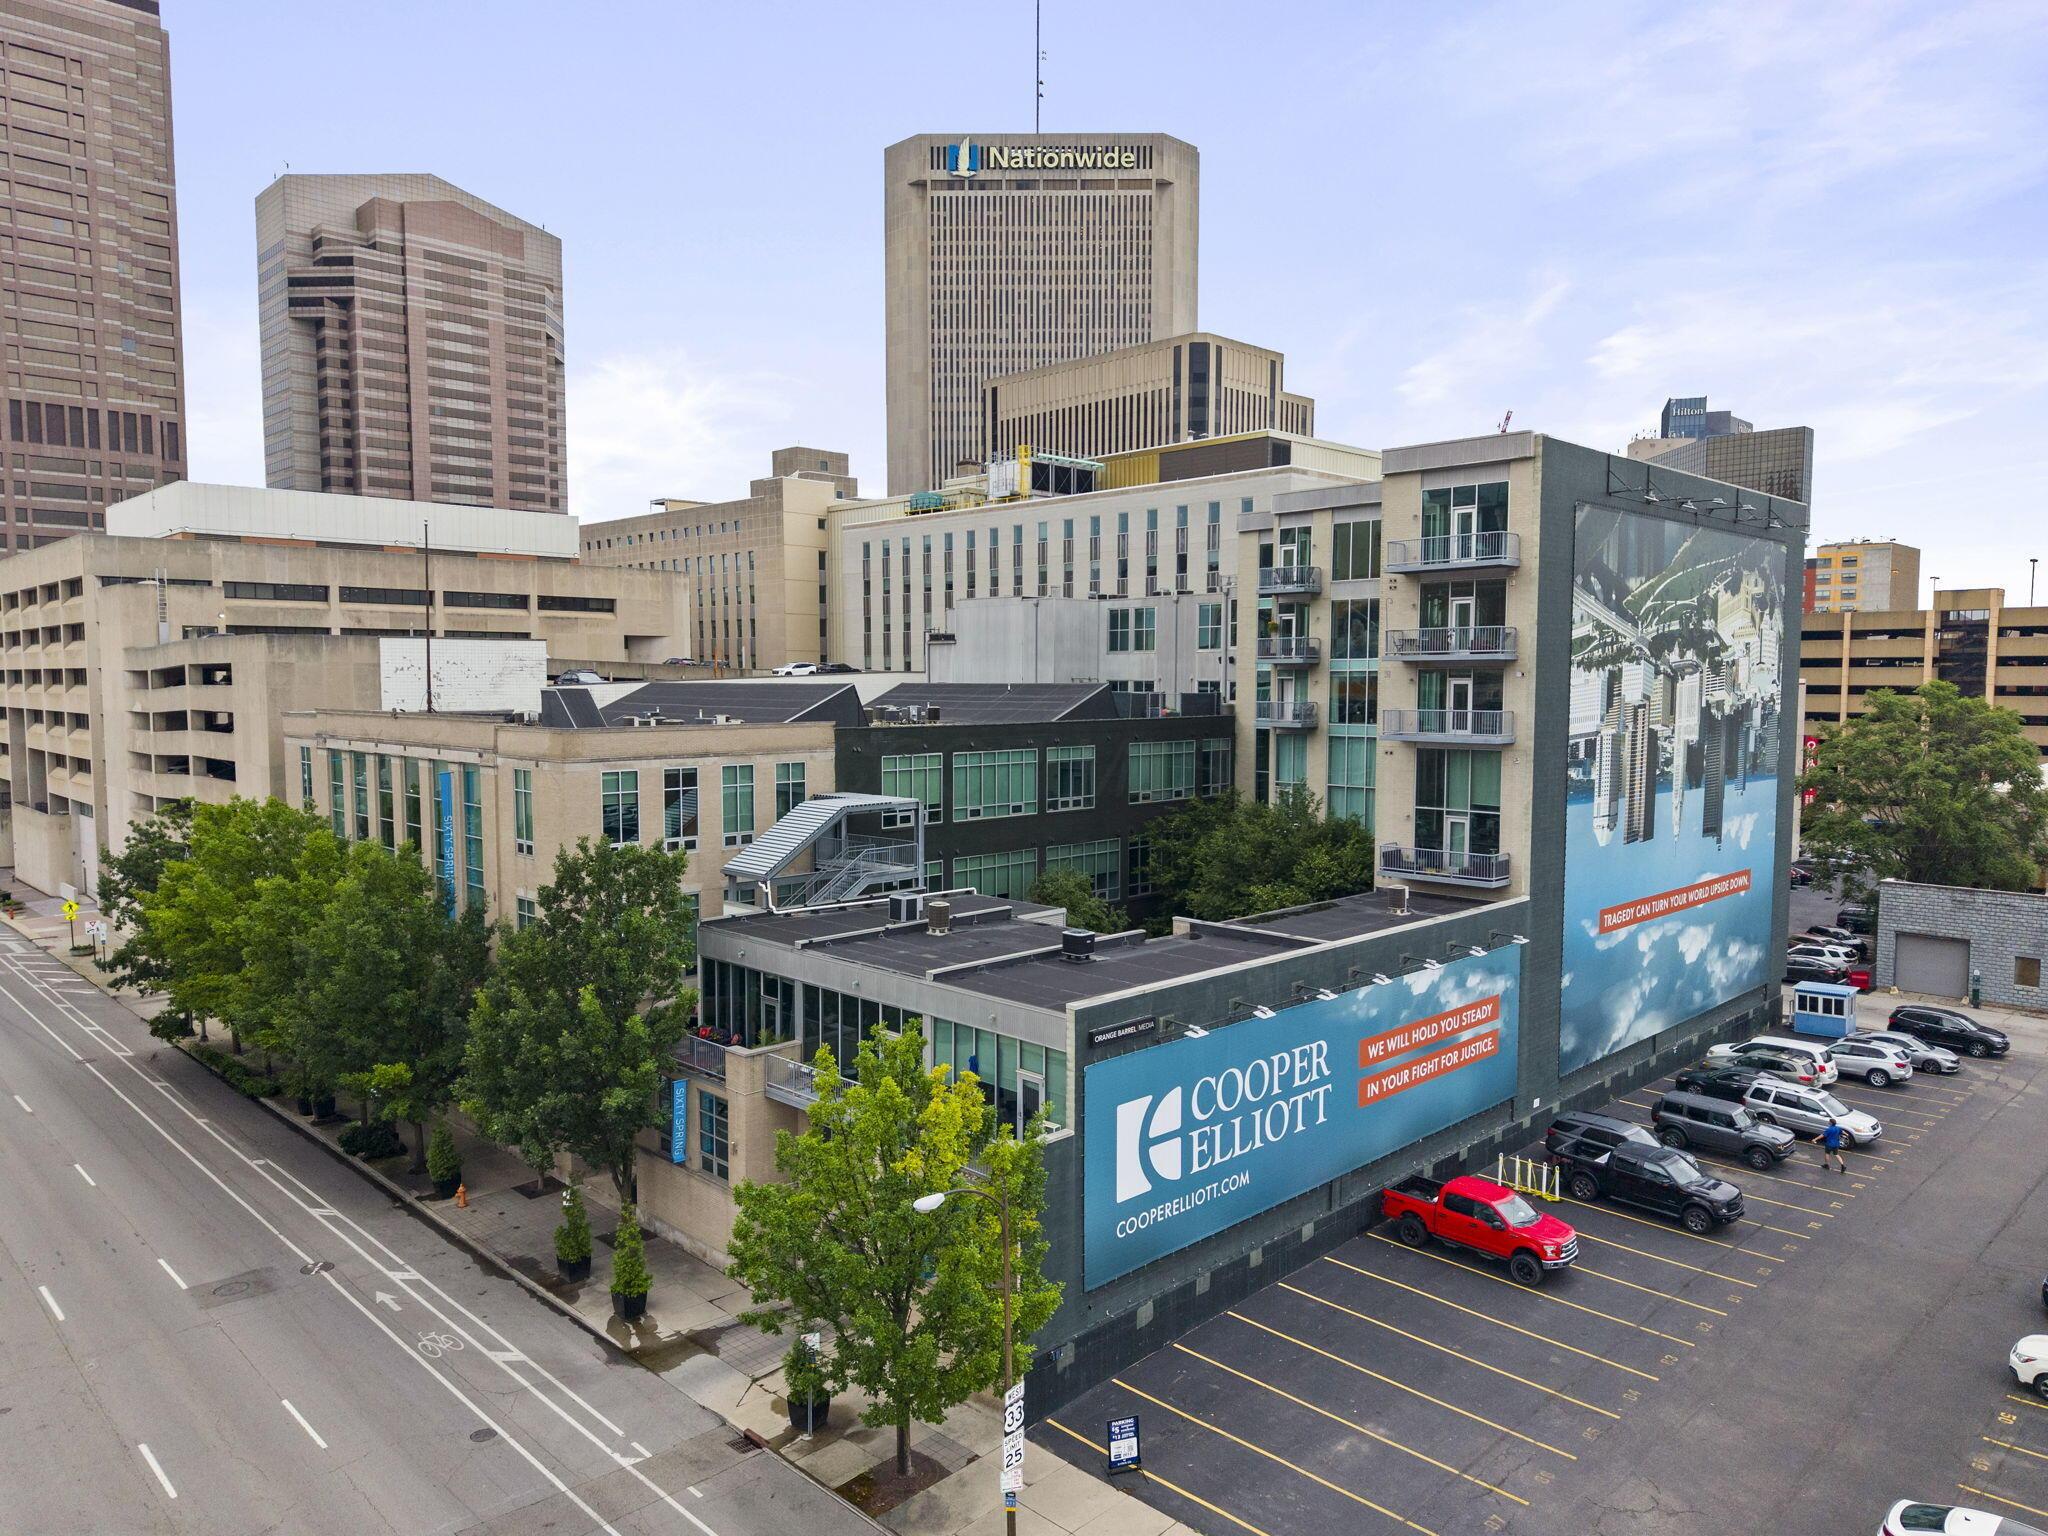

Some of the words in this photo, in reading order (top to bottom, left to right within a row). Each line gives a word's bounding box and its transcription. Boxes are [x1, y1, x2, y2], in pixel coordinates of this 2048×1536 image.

[988, 146, 1136, 170] Nationwide
[1672, 407, 1704, 417] Hilton
[443, 815, 453, 847] SIXTY
[1603, 906, 1635, 928] TRAGEDY
[1636, 902, 1651, 918] CAN
[1652, 897, 1669, 914] TURN
[1670, 892, 1688, 910] YOUR
[1688, 886, 1710, 904] WORLD
[1711, 881, 1729, 898] UPSIDE
[1730, 875, 1749, 892] DOWN.
[1094, 1031, 1117, 1043] ORANGE
[1117, 1026, 1137, 1037] BARREL
[1138, 1021, 1155, 1031] MEDIA
[1368, 1041, 1384, 1059] WE
[1386, 1032, 1410, 1052] WILL
[1412, 1022, 1438, 1044] HOLD
[1440, 1016, 1460, 1034] YOU
[1461, 1003, 1493, 1025] STEADY
[1367, 1082, 1379, 1098] IN
[1381, 1069, 1409, 1092] YOUR
[1412, 1057, 1439, 1080] FIGHT
[1441, 1051, 1459, 1069] FOR
[1460, 1037, 1495, 1062] JUSTICE.
[1191, 1040, 1332, 1121] COOPER
[675, 1087, 685, 1115] SIXTY
[674, 1118, 685, 1156] SPRING
[1189, 1084, 1332, 1174] ELLIOTT
[1116, 1170, 1250, 1239] COOPERELLIOTT.COM
[1727, 1294, 1743, 1303] 01
[1660, 1354, 1679, 1366] 03
[1008, 1386, 1022, 1400] WEST
[1623, 1388, 1642, 1401] 04
[1007, 1405, 1022, 1428] 33
[1111, 1417, 1135, 1427] PARKING
[1998, 1412, 2017, 1425] 50
[1004, 1432, 1023, 1447] SPEED
[1006, 1440, 1020, 1454] LIMIT
[1005, 1447, 1022, 1469] 25
[1483, 1513, 1506, 1531] 07
